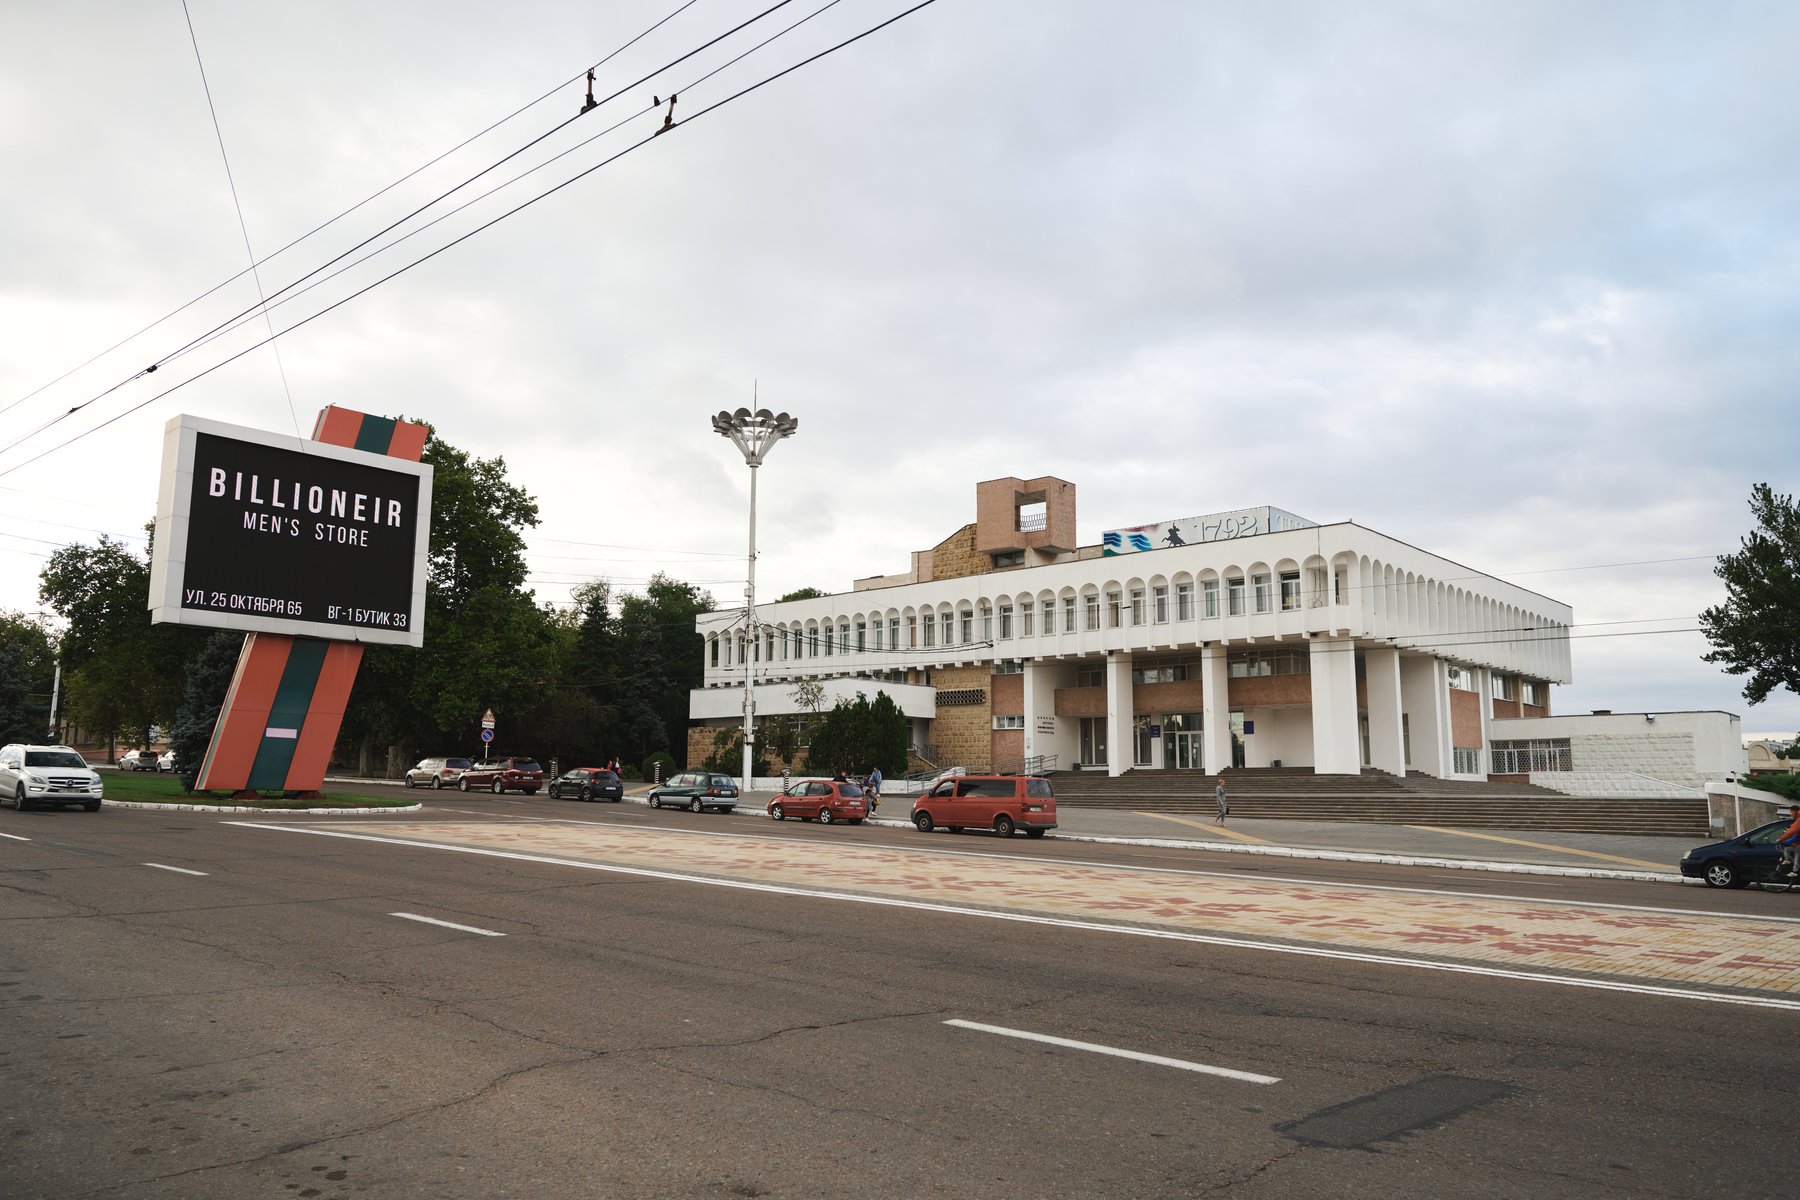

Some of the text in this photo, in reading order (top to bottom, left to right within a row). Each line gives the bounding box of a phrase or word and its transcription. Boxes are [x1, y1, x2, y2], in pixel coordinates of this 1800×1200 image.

[209, 467, 402, 528] BILLIONEIR
[243, 511, 369, 547] MEN'S STORE
[1194, 516, 1258, 541] 1792
[186, 588, 302, 616] УЛ. 25 ОКТЯБРЯ 65
[328, 605, 407, 627] ВГ-1 БУТИК 33
